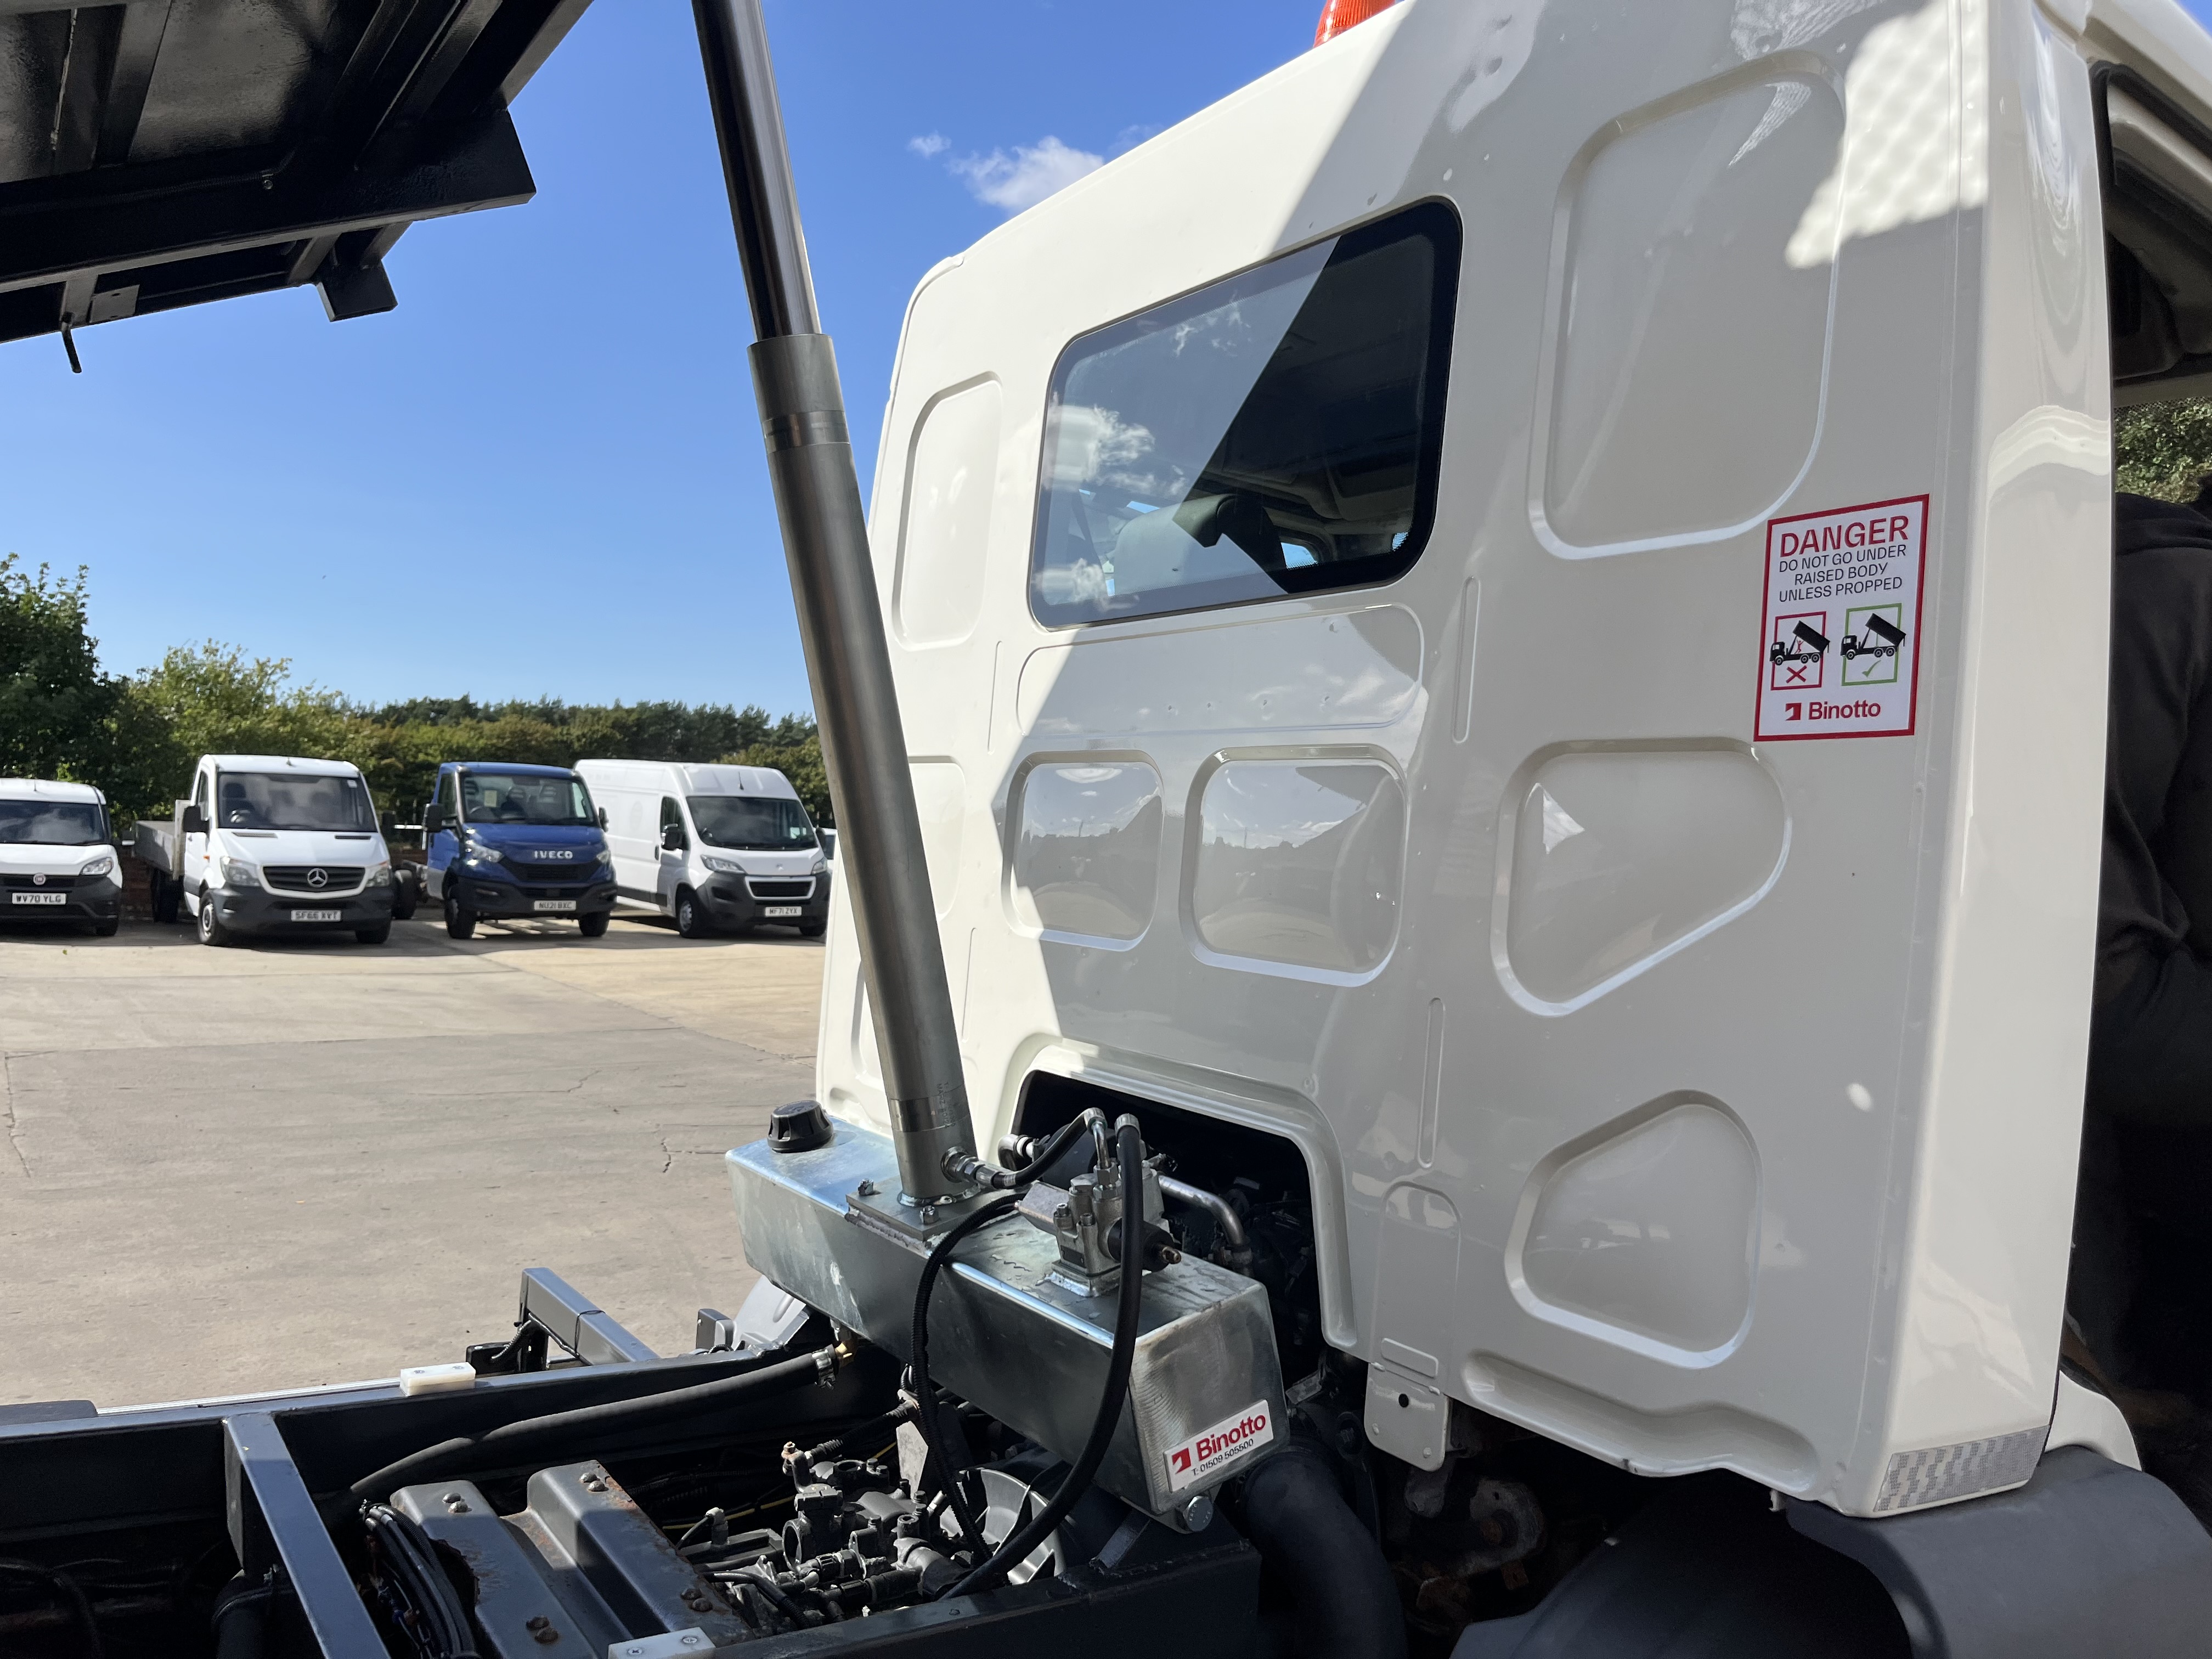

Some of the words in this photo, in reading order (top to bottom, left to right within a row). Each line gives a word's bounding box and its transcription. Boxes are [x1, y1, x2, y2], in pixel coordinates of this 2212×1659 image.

[1780, 515, 1909, 557] DANGER
[1779, 559, 1798, 572] DO
[1802, 555, 1829, 569] NOT
[1832, 551, 1852, 565] GO
[1857, 544, 1906, 561] UNDER
[1795, 568, 1844, 585] RAISED
[1848, 562, 1888, 579] BODY
[1779, 585, 1832, 602] UNLESS
[1836, 577, 1903, 596] PROPPED
[1808, 699, 1881, 720] Binotto
[534, 850, 573, 860] IVECO
[1196, 1414, 1266, 1462] Binotto
[1191, 1468, 1199, 1476] T:
[1200, 1455, 1223, 1472] 01509
[1224, 1438, 1254, 1460] 505500
